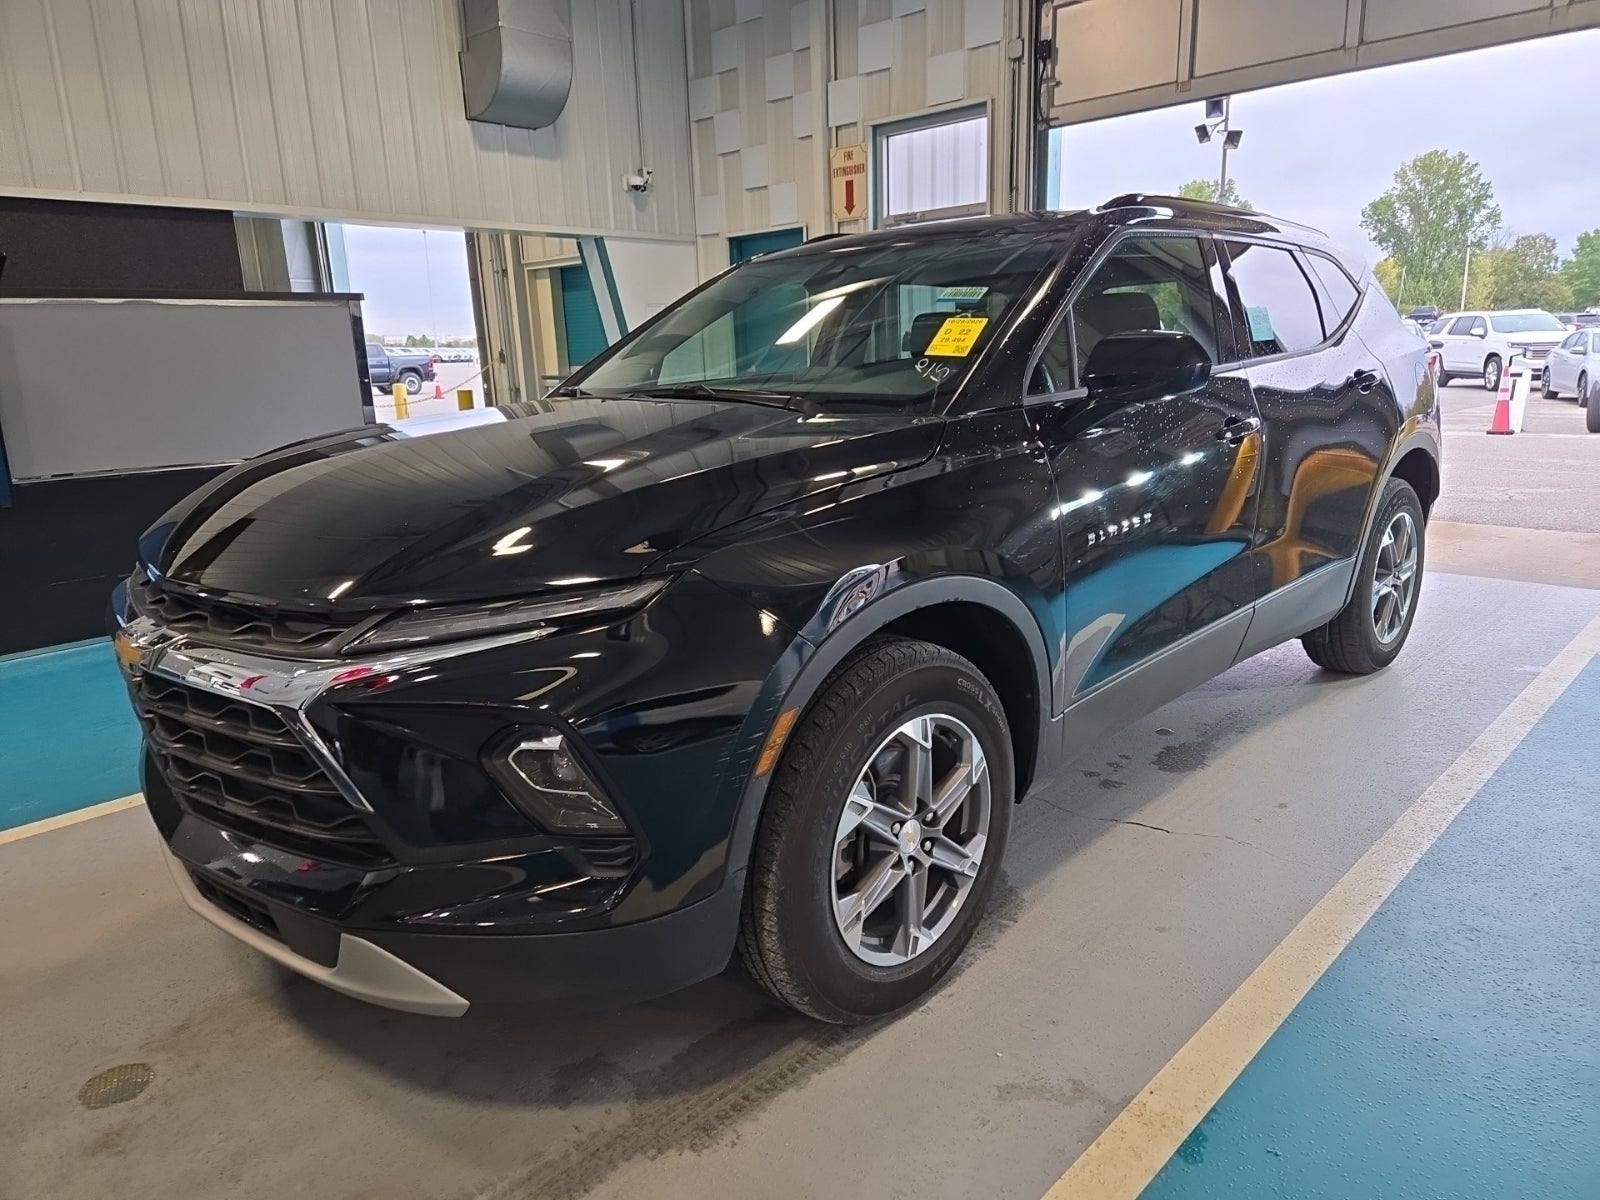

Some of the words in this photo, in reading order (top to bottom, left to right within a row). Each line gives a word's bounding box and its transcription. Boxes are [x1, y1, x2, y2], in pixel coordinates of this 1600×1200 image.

[843, 150, 854, 162] FIRE
[833, 163, 865, 179] EXTINGUISHER
[1087, 512, 1153, 547] BLAZER
